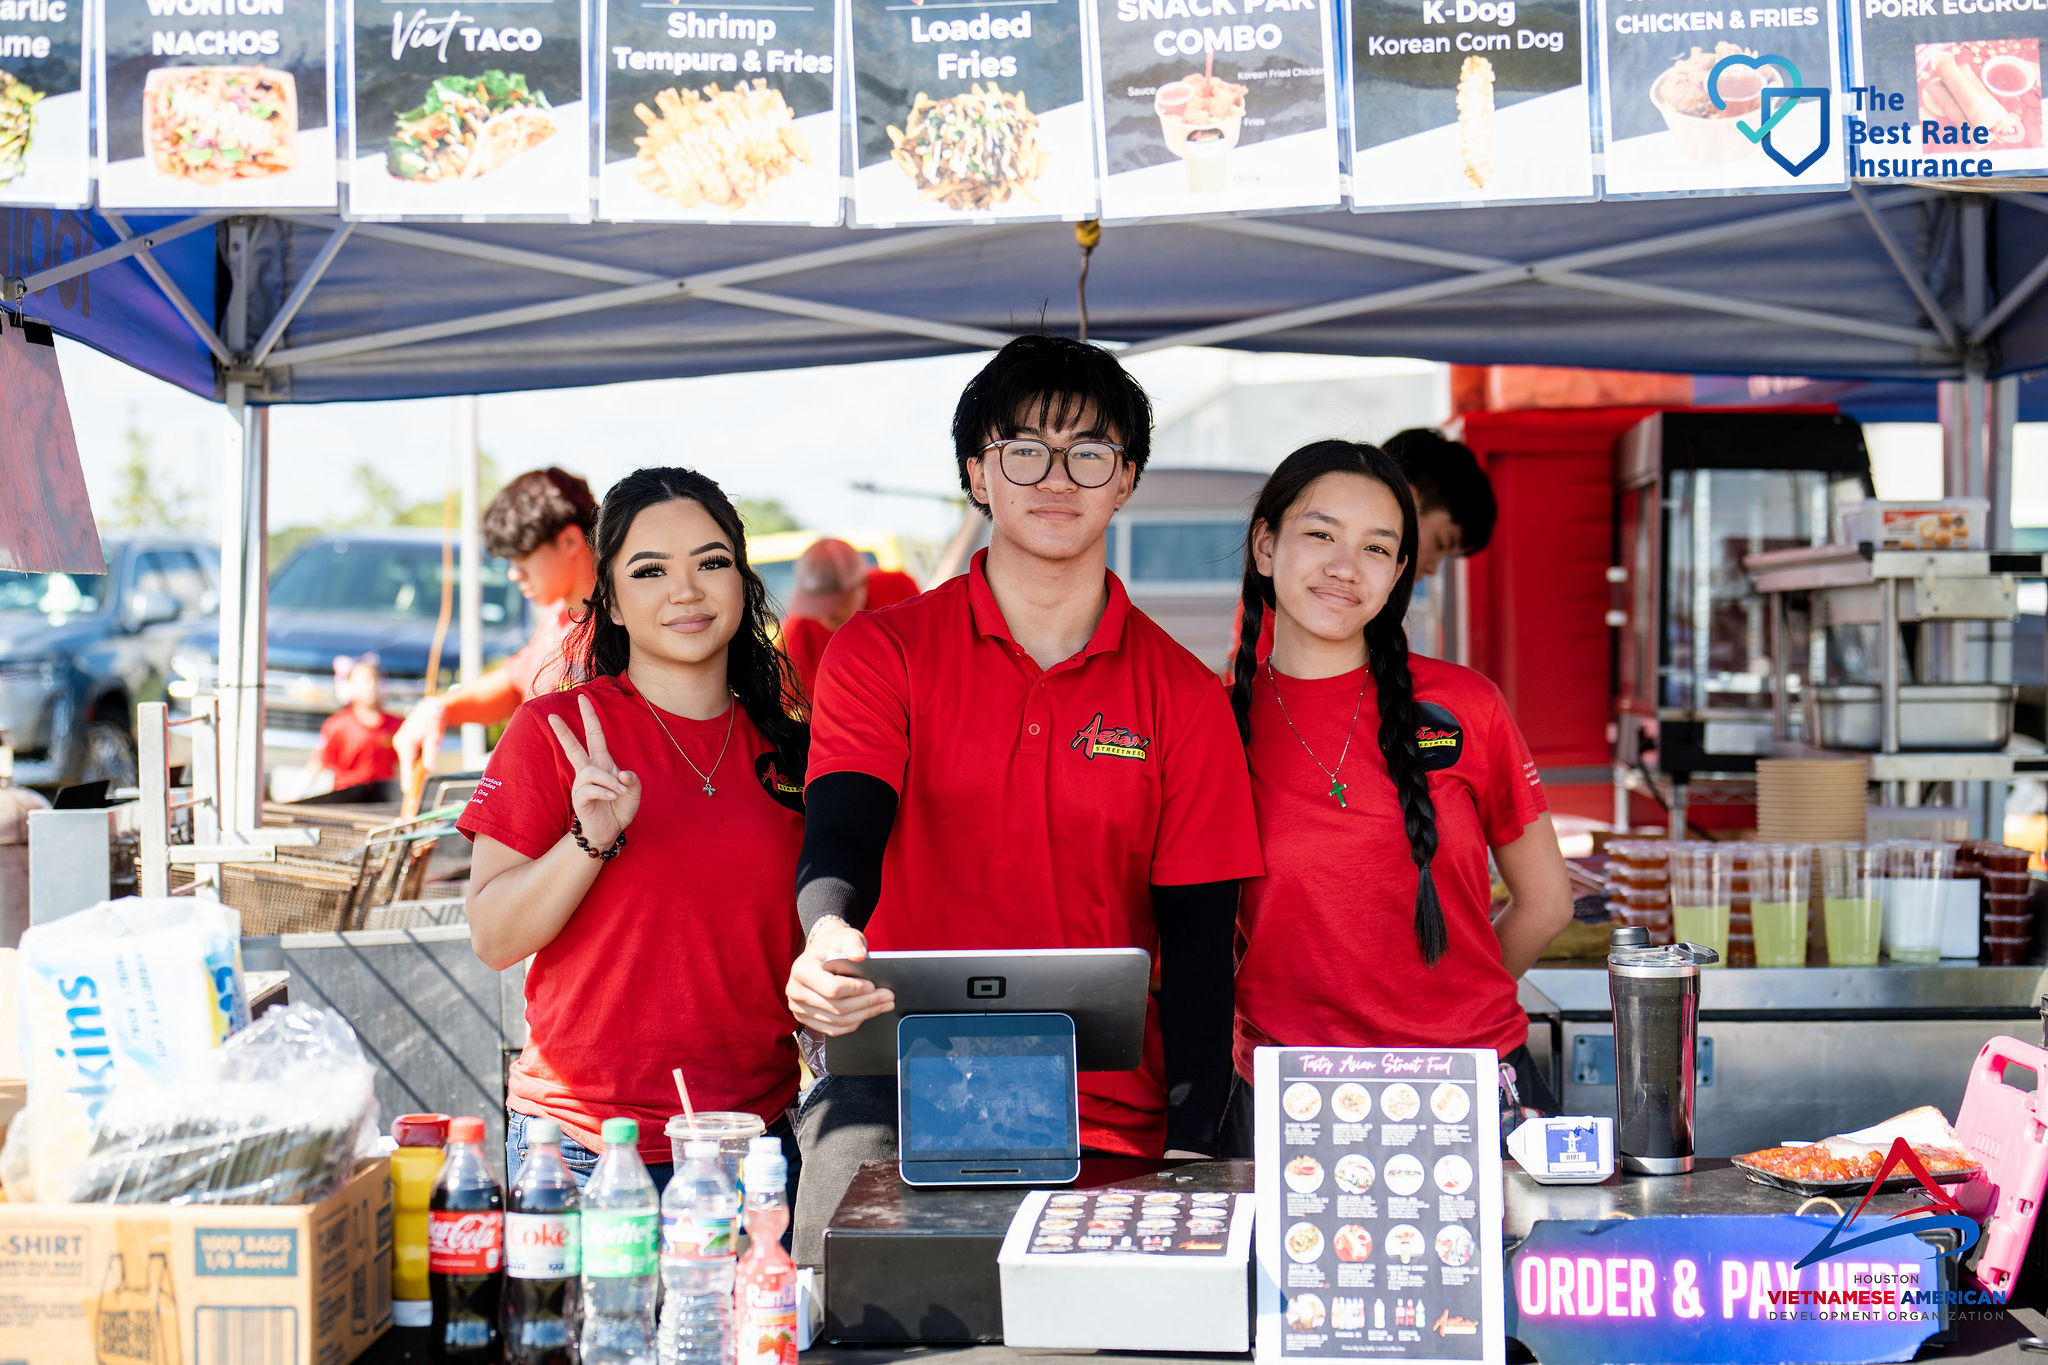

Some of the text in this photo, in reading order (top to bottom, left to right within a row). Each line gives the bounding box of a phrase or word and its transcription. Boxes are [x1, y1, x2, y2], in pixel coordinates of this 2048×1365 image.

[1117, 0, 1237, 22] SNACK
[1422, 0, 1516, 27] K-Dog
[1615, 6, 1820, 34] CHICKEN & FRIES
[1865, 0, 2048, 19] PORK EGGROL
[391, 9, 543, 63] Viet TACO
[666, 11, 777, 46] Shrimp
[910, 11, 1032, 43] Loaded
[1153, 23, 1283, 57] COMBO
[0, 35, 51, 58] me
[152, 29, 280, 56] NACHOS
[1368, 29, 1564, 56] Korean Corn Dog
[611, 46, 834, 76] Tempura & Fries
[937, 50, 1018, 80] Fries
[1237, 66, 1324, 81] Korean Fried Chicken
[1127, 87, 1156, 97] Sauce
[1243, 117, 1266, 127] Fries
[1071, 713, 1149, 759] Asian
[1094, 745, 1145, 758] STREETNESS
[1298, 1052, 1454, 1076] Tasty Asian Street Food
[244, 1235, 292, 1253] BAGS
[511, 1222, 571, 1248] Coke
[1520, 1256, 1656, 1318] ORDER
[1672, 1259, 1705, 1318] &
[1722, 1260, 1801, 1320] PAY
